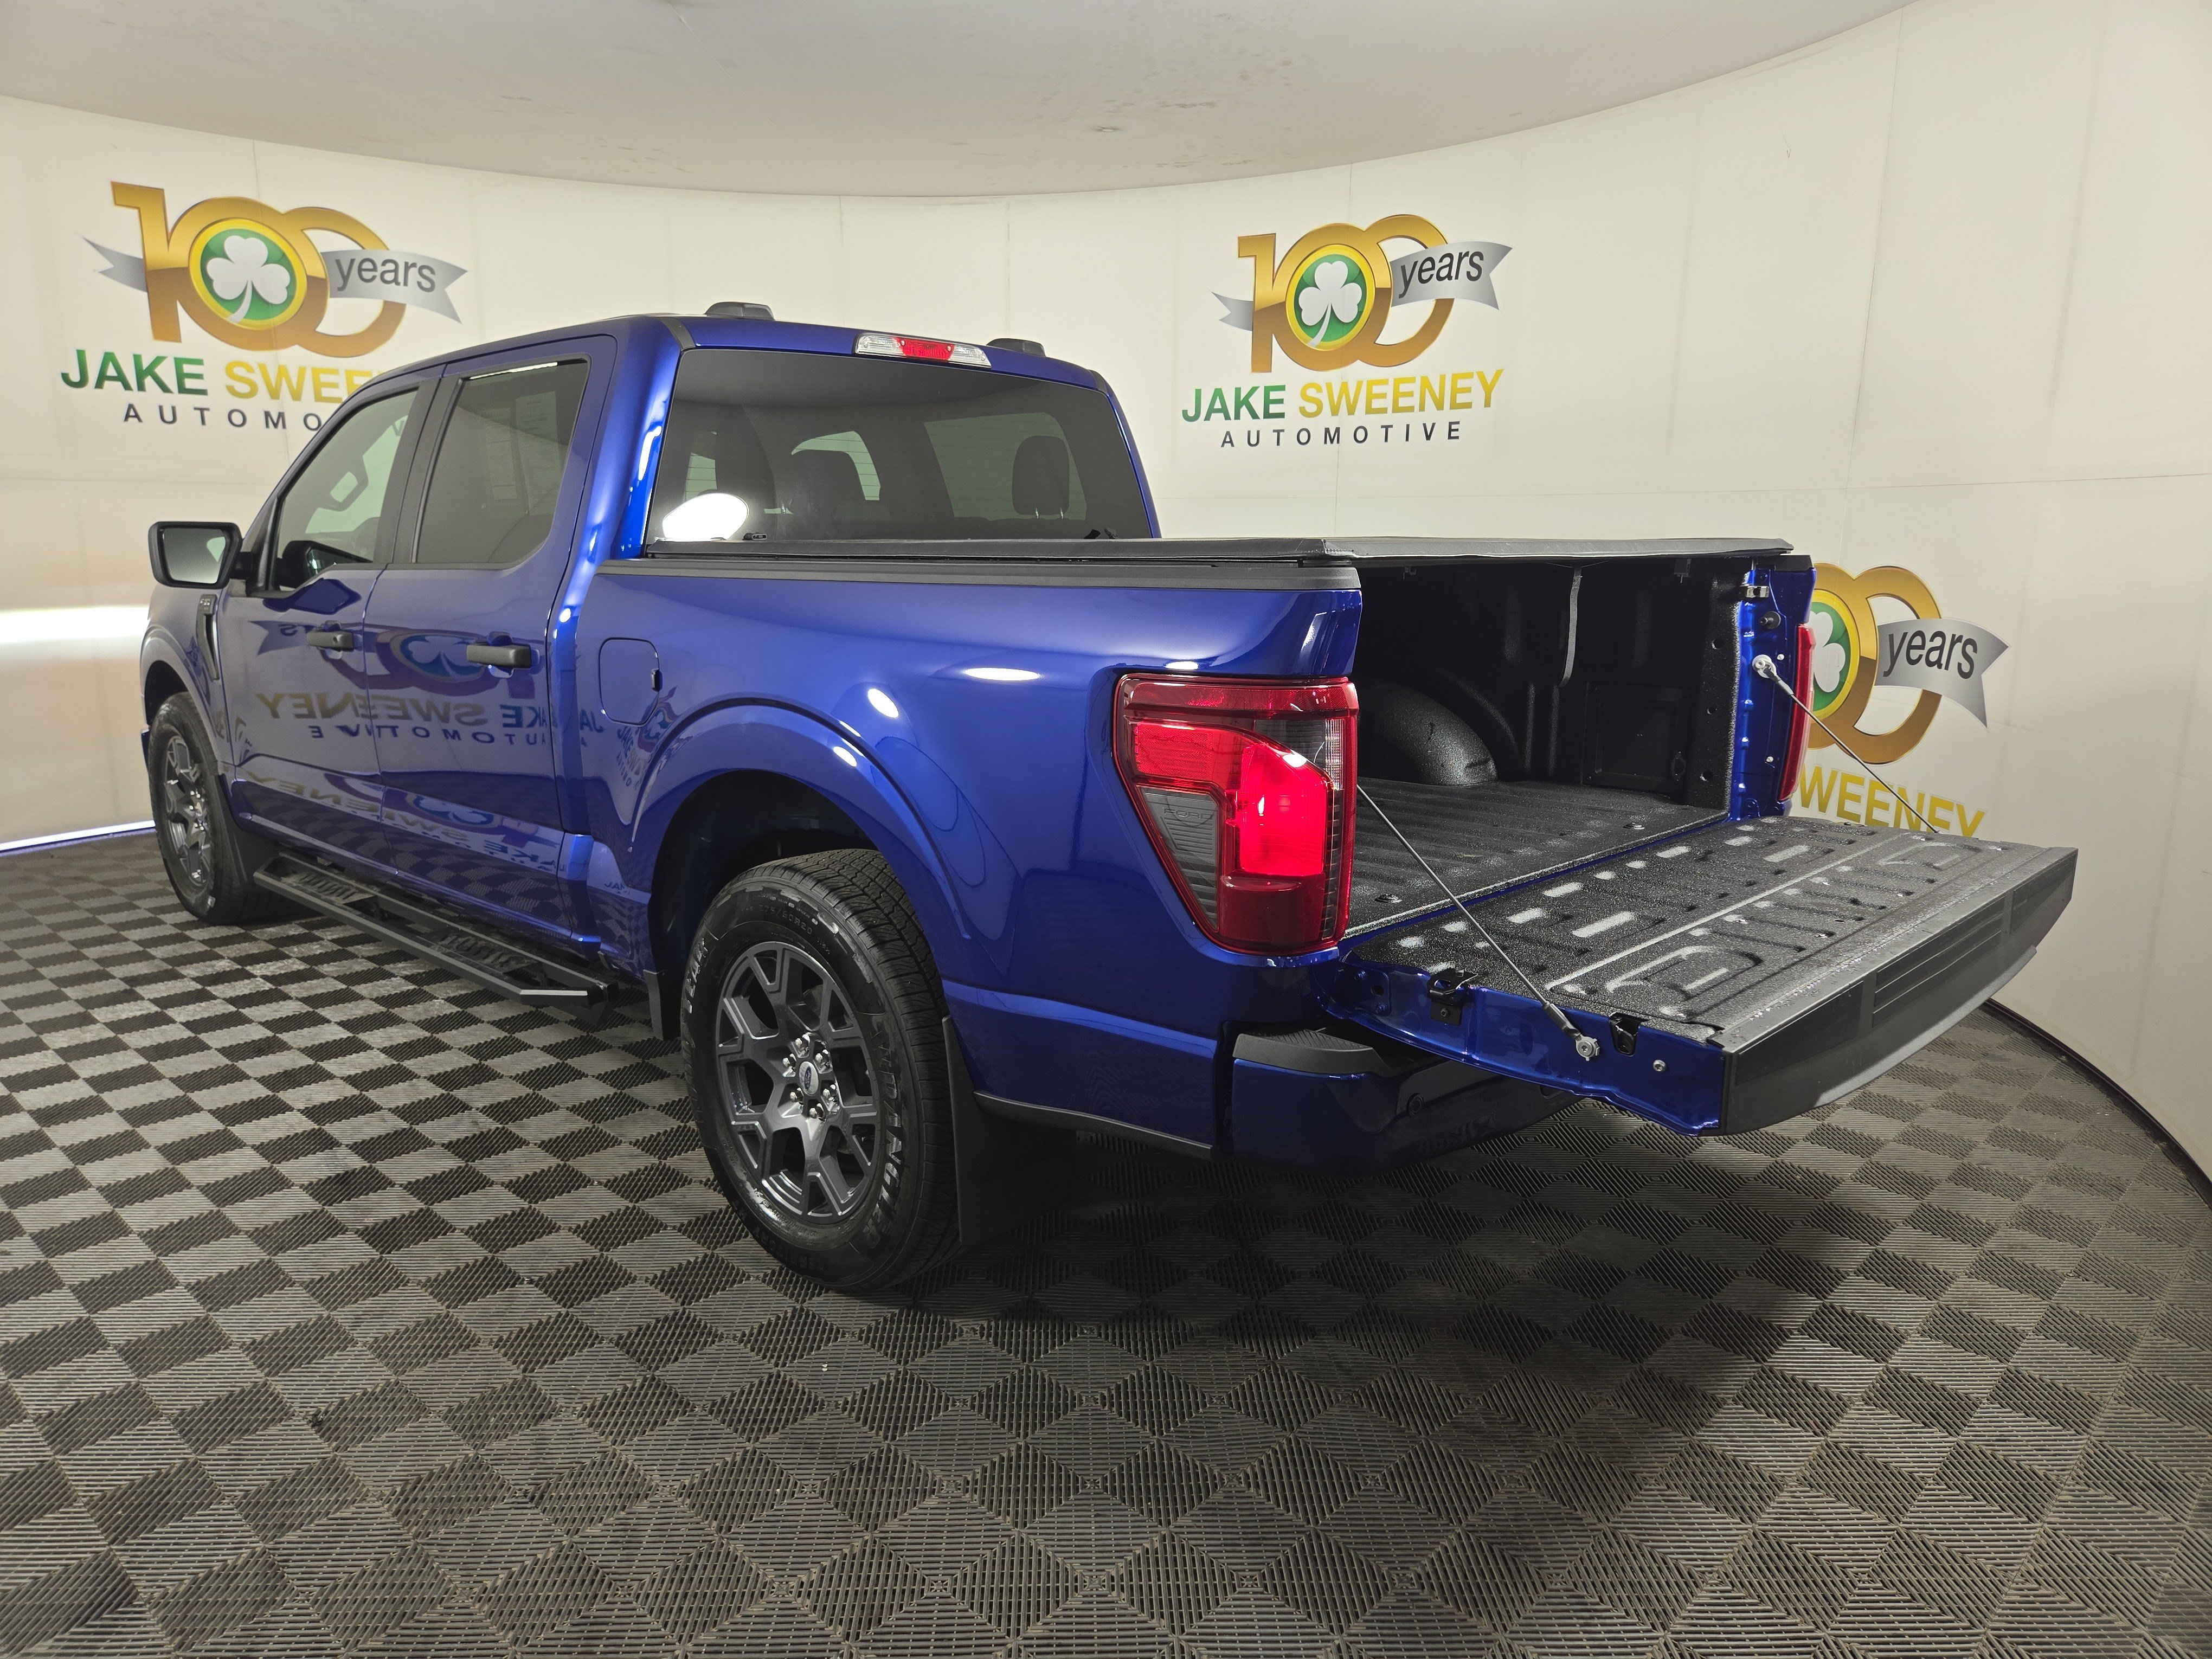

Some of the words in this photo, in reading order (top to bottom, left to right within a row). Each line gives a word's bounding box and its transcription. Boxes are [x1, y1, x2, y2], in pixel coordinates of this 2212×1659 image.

[335, 253, 436, 292] years
[1398, 251, 1484, 299] years
[61, 349, 208, 396] JAKE
[224, 360, 383, 404] SWEE
[1181, 384, 1286, 422] JAKE
[1298, 369, 1504, 419] SWEENEY
[123, 403, 322, 432] AUTOMO
[1220, 421, 1461, 448] AUTOMOTIVE
[1882, 630, 1978, 680] years
[1163, 808, 1213, 820] FORD
[1799, 763, 1986, 838] WEENEY
